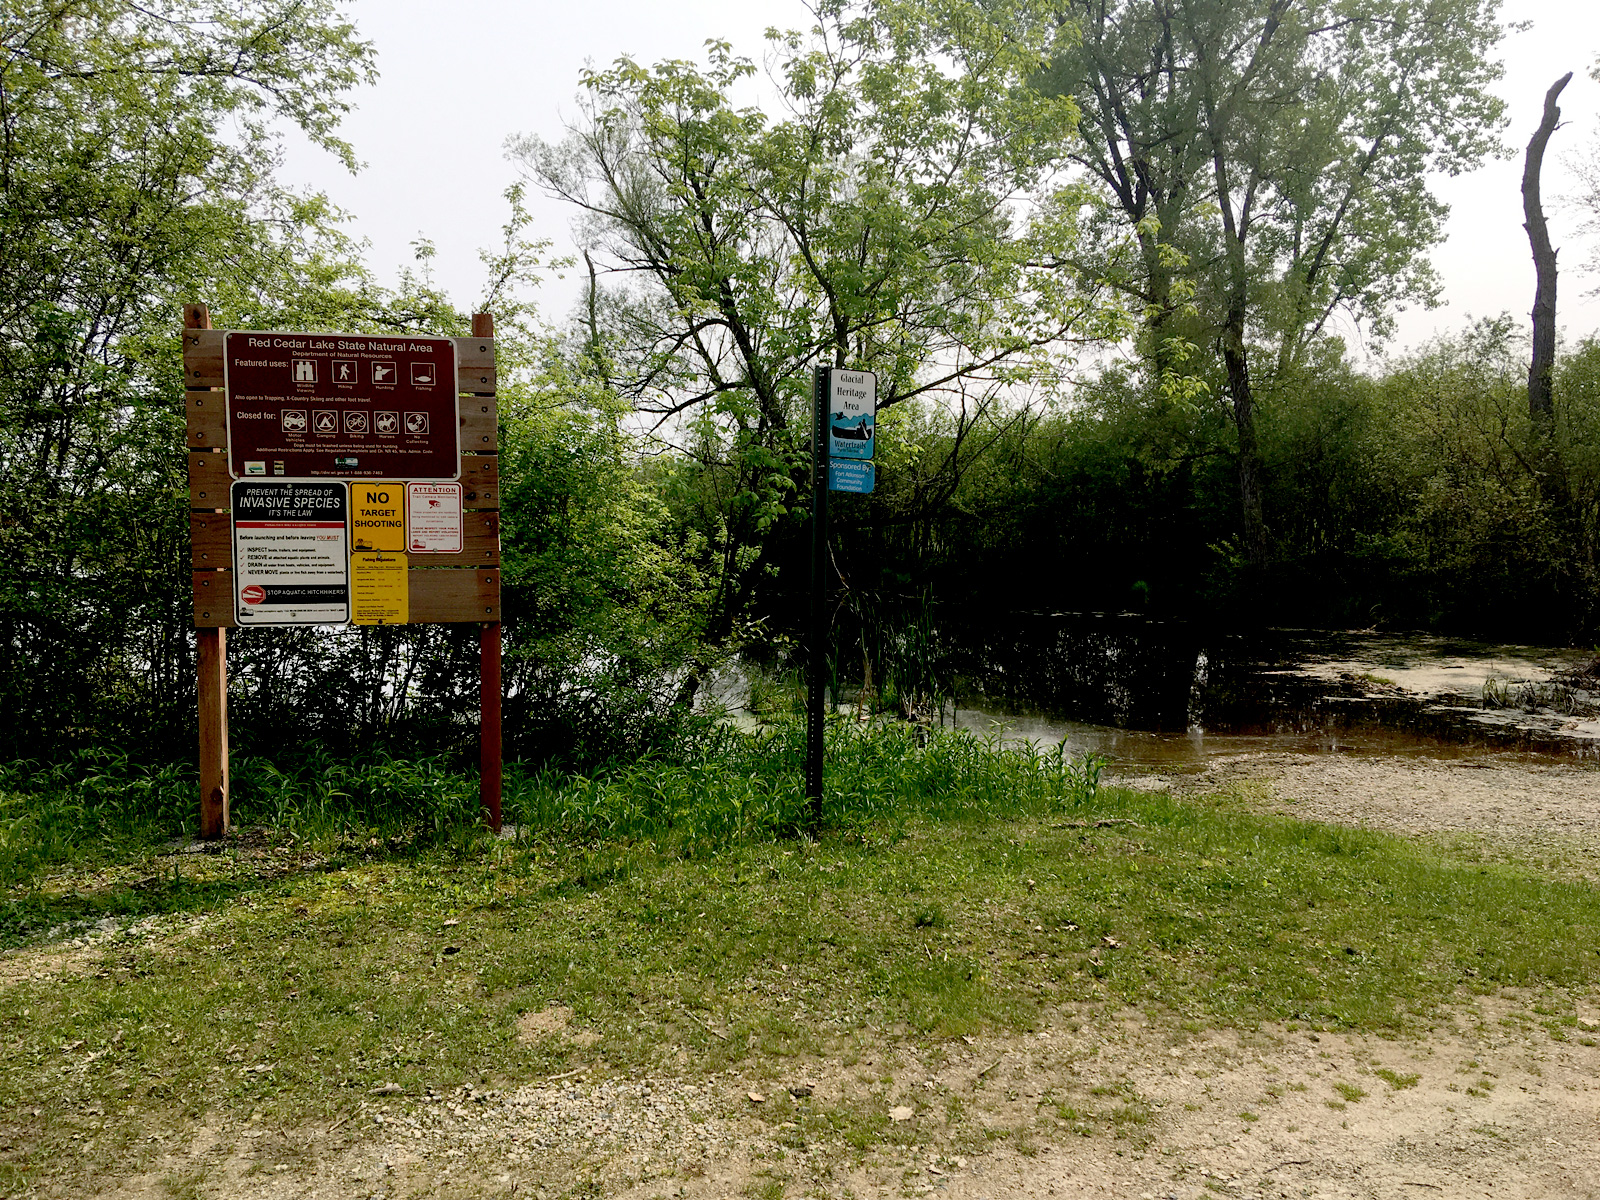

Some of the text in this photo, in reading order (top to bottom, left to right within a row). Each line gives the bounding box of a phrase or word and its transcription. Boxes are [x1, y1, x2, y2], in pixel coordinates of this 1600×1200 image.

[248, 338, 433, 352] Red Cedar Lake State Natural Area
[840, 373, 864, 384] Glacial
[837, 387, 866, 399] Heritage
[843, 401, 859, 410] Area
[835, 440, 866, 449] Watertrails
[830, 461, 861, 470] Sponsored
[240, 497, 340, 508] INVASIVE SPECIES
[366, 492, 389, 504] NO
